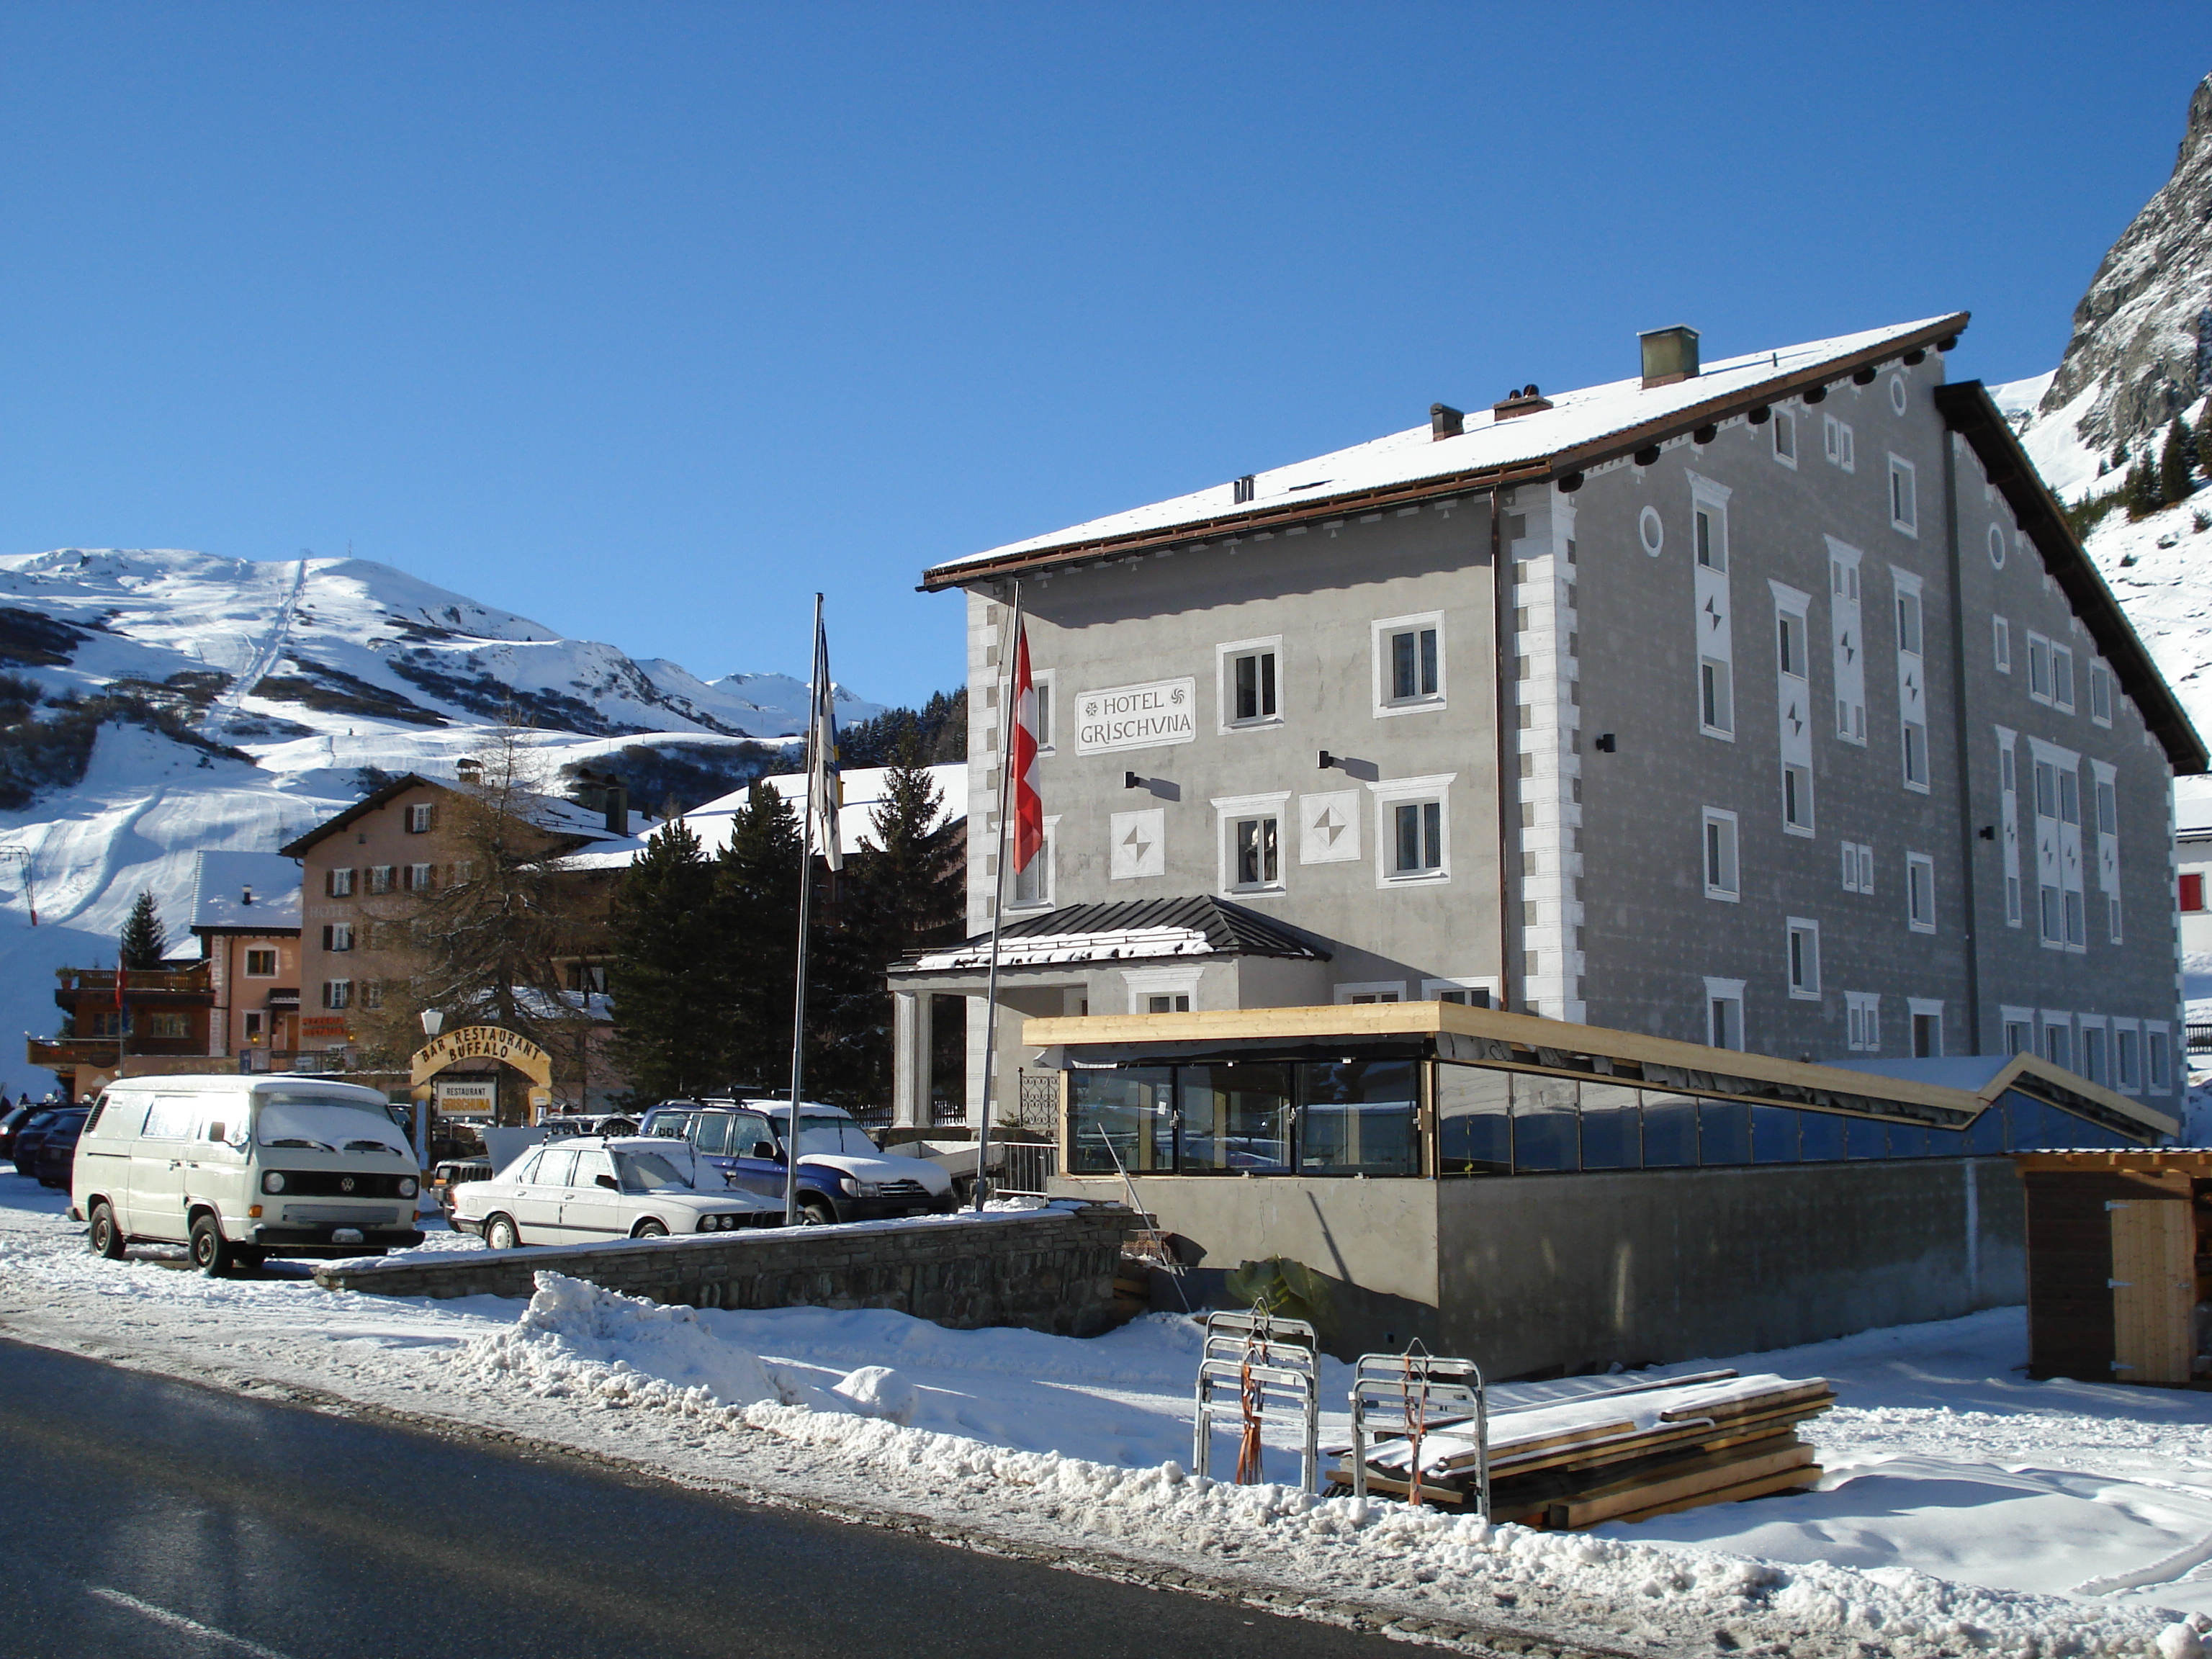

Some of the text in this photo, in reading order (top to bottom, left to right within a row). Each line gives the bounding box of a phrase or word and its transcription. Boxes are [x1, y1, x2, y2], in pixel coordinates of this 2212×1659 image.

[1103, 692, 1164, 715] HOTEL
[310, 904, 352, 919] HOTEL
[421, 1028, 541, 1063] BAR RESTAURANT
[449, 1041, 508, 1061] BUFFALO
[446, 1087, 486, 1096] RESTAURANT
[441, 1098, 491, 1112] GRISCHUNA
